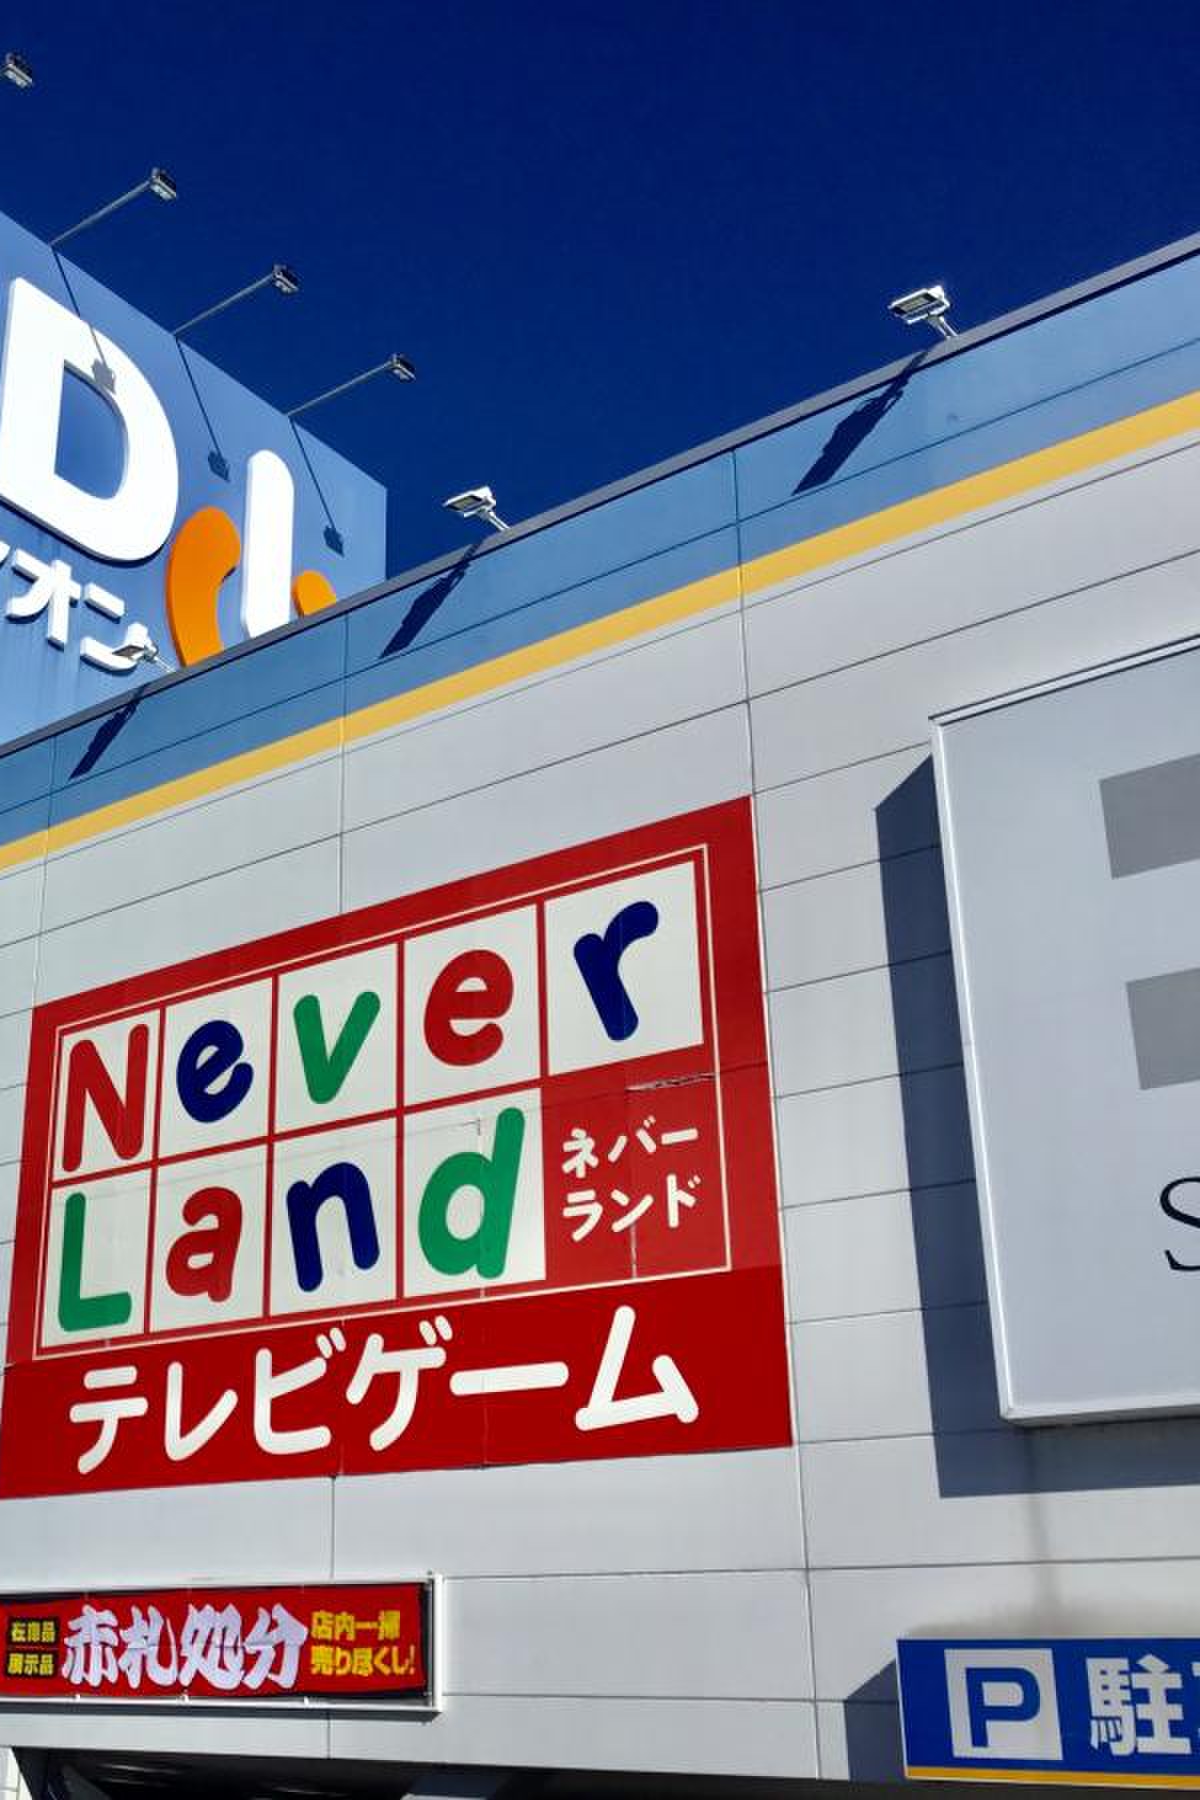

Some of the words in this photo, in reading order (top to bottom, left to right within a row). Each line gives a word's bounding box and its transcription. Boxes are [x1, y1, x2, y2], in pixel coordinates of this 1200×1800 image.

[61, 900, 660, 1173] Never
[561, 1115, 699, 1180] ネバー
[57, 1107, 526, 1333] Land
[561, 1174, 703, 1242] ランド
[67, 1304, 700, 1474] テレビゲーム
[7, 1653, 54, 1676] 展示品
[61, 1603, 308, 1690] 赤札処分
[310, 1609, 401, 1641] 店内一掃
[964, 1667, 1042, 1749] P
[1086, 1653, 1200, 1757] 駐
